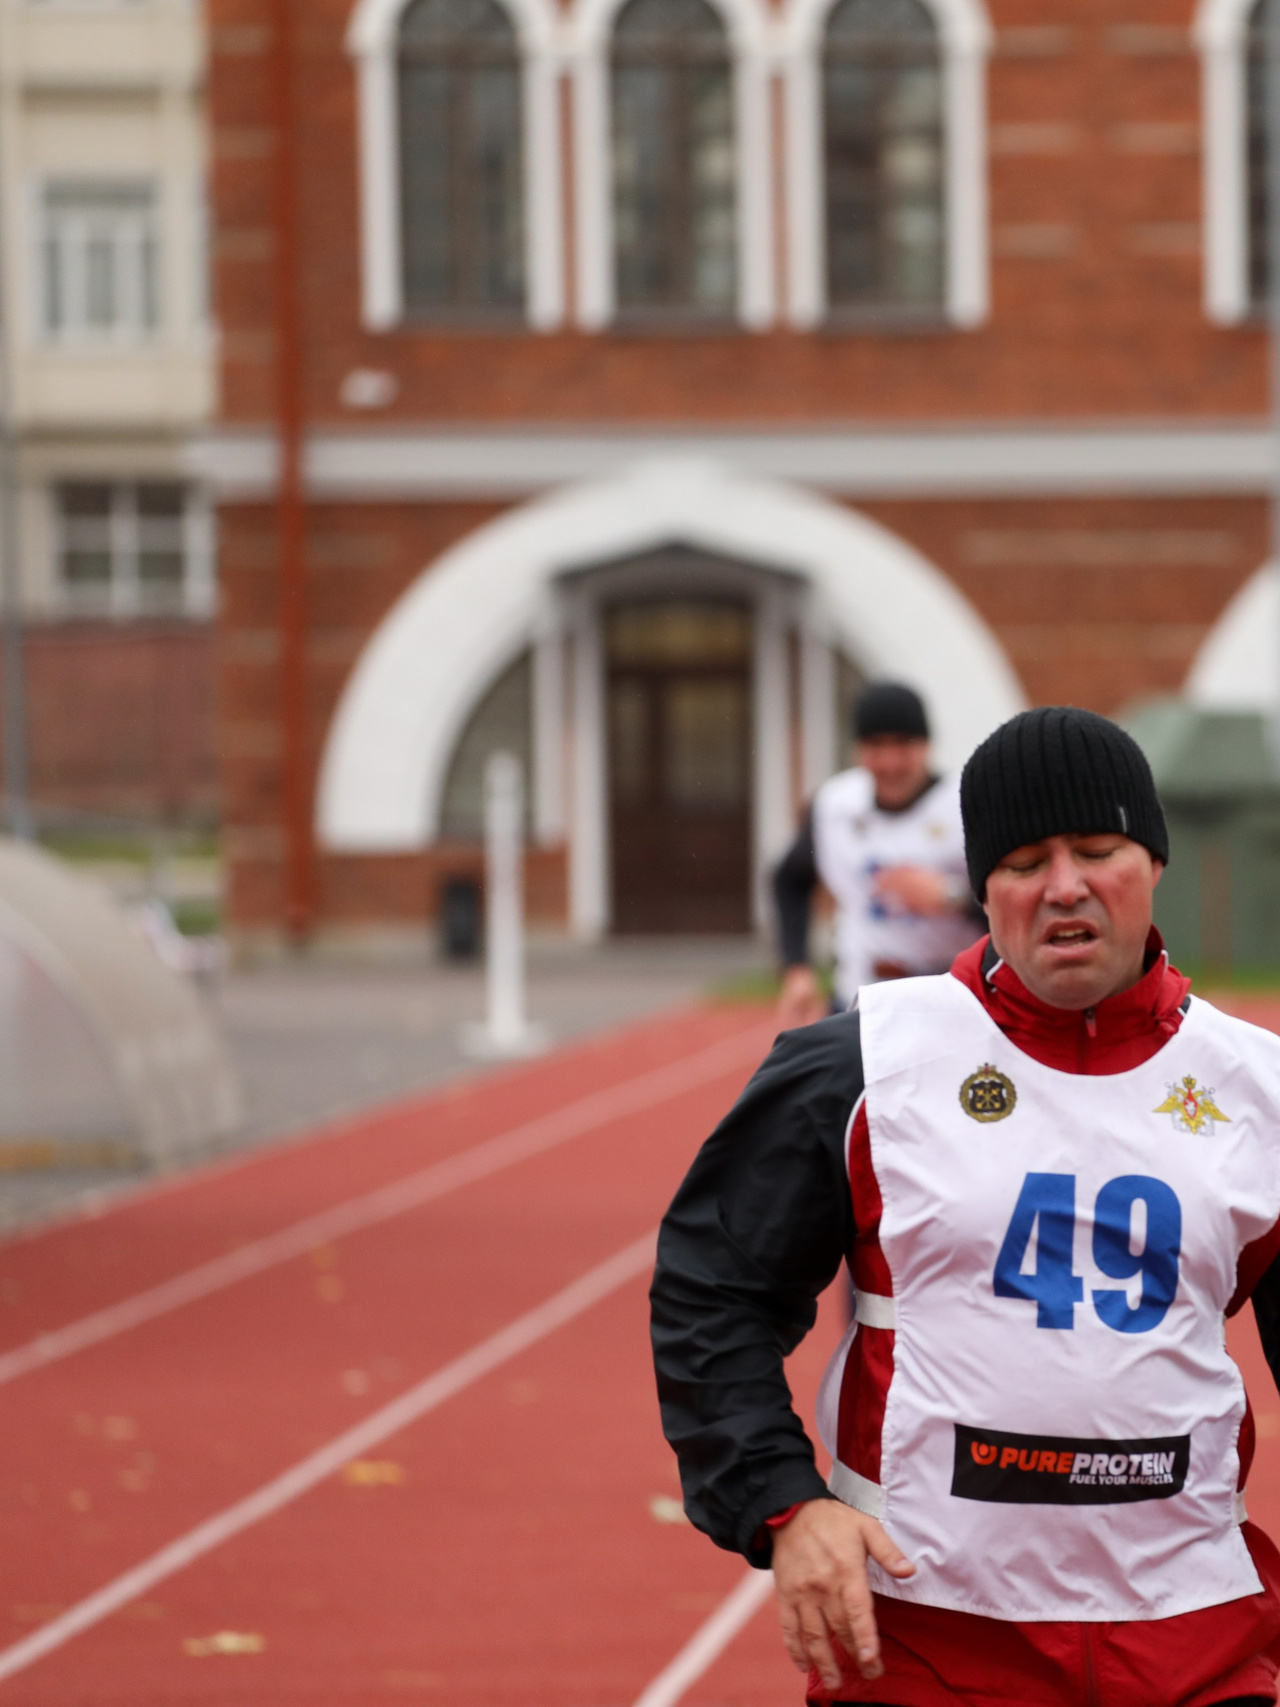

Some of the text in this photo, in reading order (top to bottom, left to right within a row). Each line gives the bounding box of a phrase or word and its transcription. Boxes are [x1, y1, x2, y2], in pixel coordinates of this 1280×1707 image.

[993, 1172, 1182, 1334] 49
[1069, 1474, 1097, 1484] FUEL
[1099, 1474, 1128, 1485] YOUR
